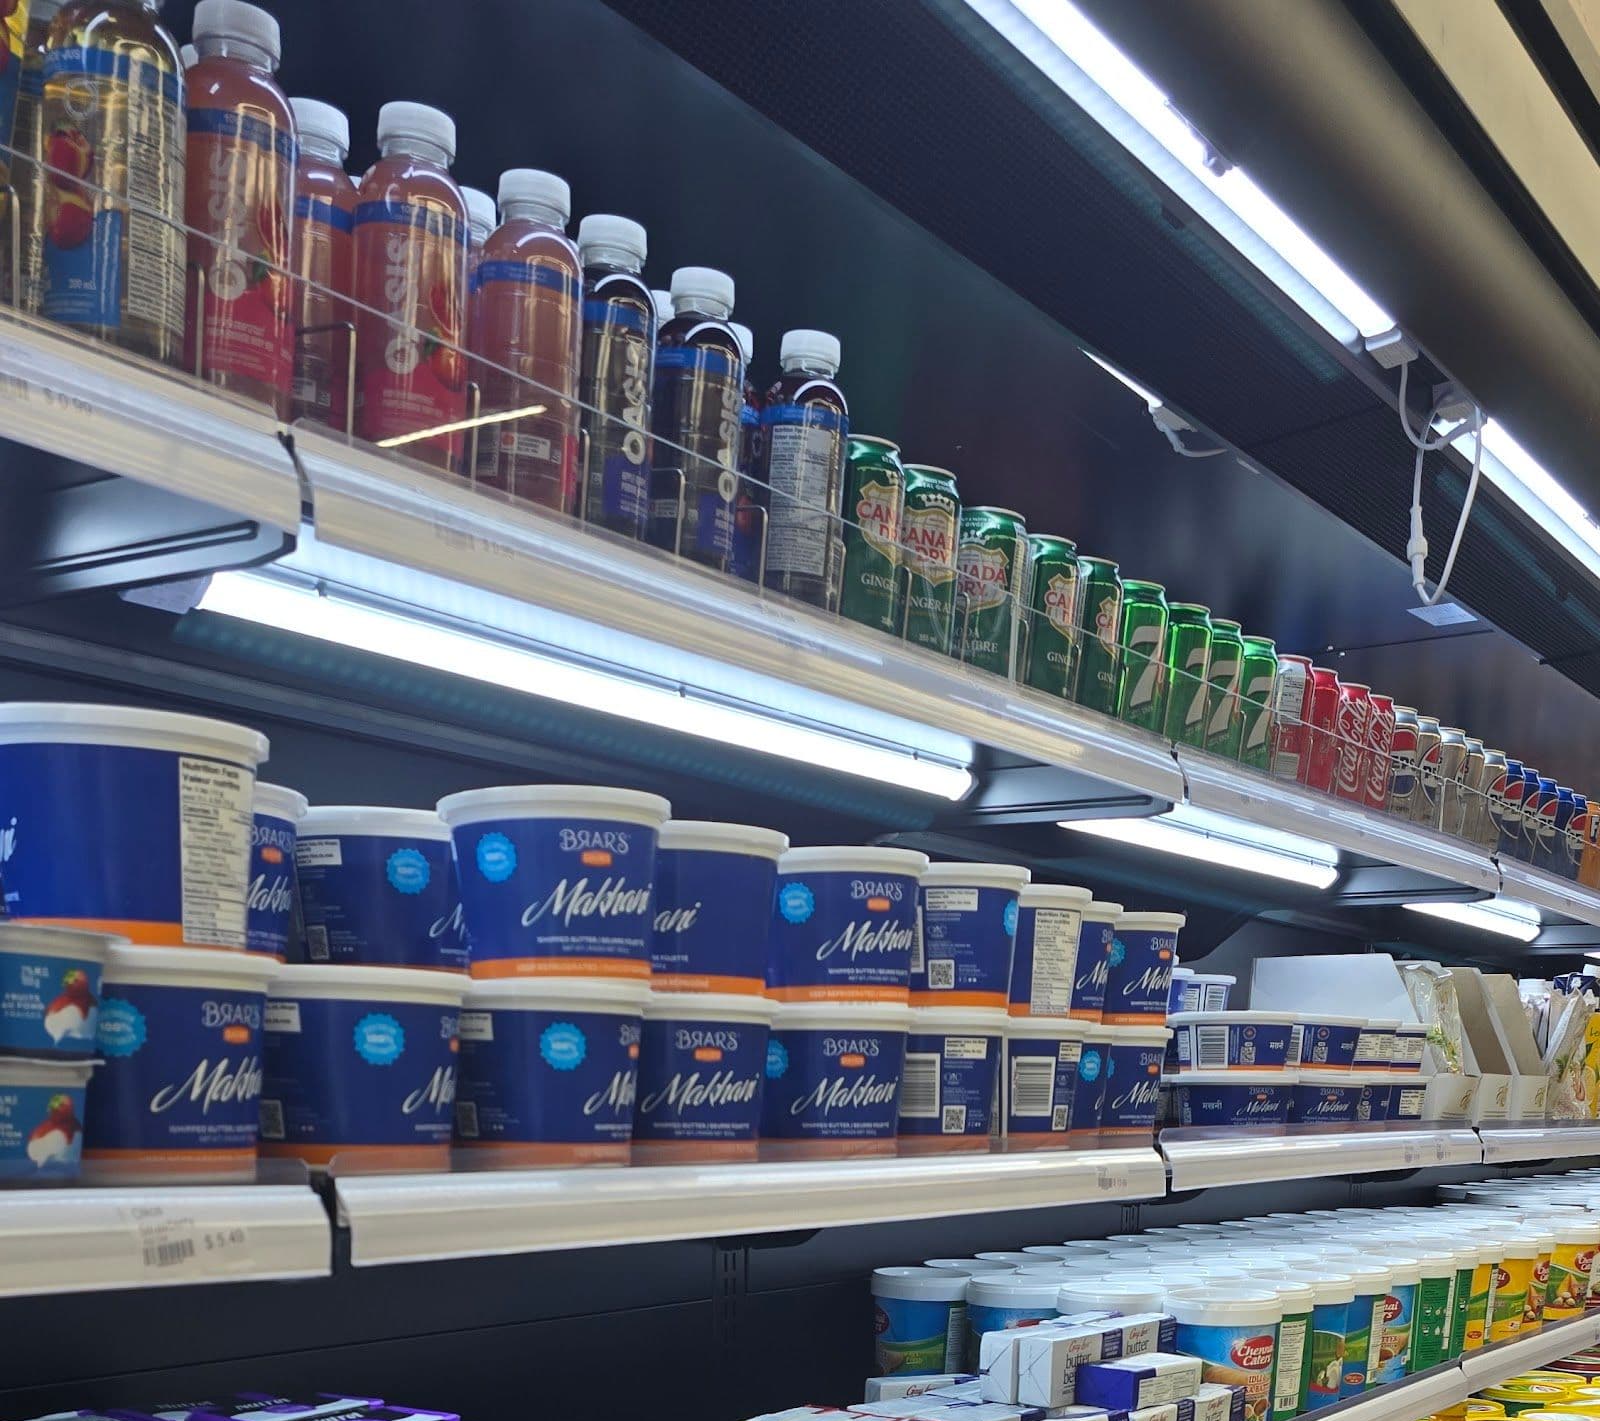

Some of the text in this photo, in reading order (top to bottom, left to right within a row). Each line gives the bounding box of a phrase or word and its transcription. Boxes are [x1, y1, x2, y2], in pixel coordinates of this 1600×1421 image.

[521, 876, 653, 928] Makhani
[641, 1070, 760, 1115] Makhani
[791, 1076, 899, 1116] Makhani
